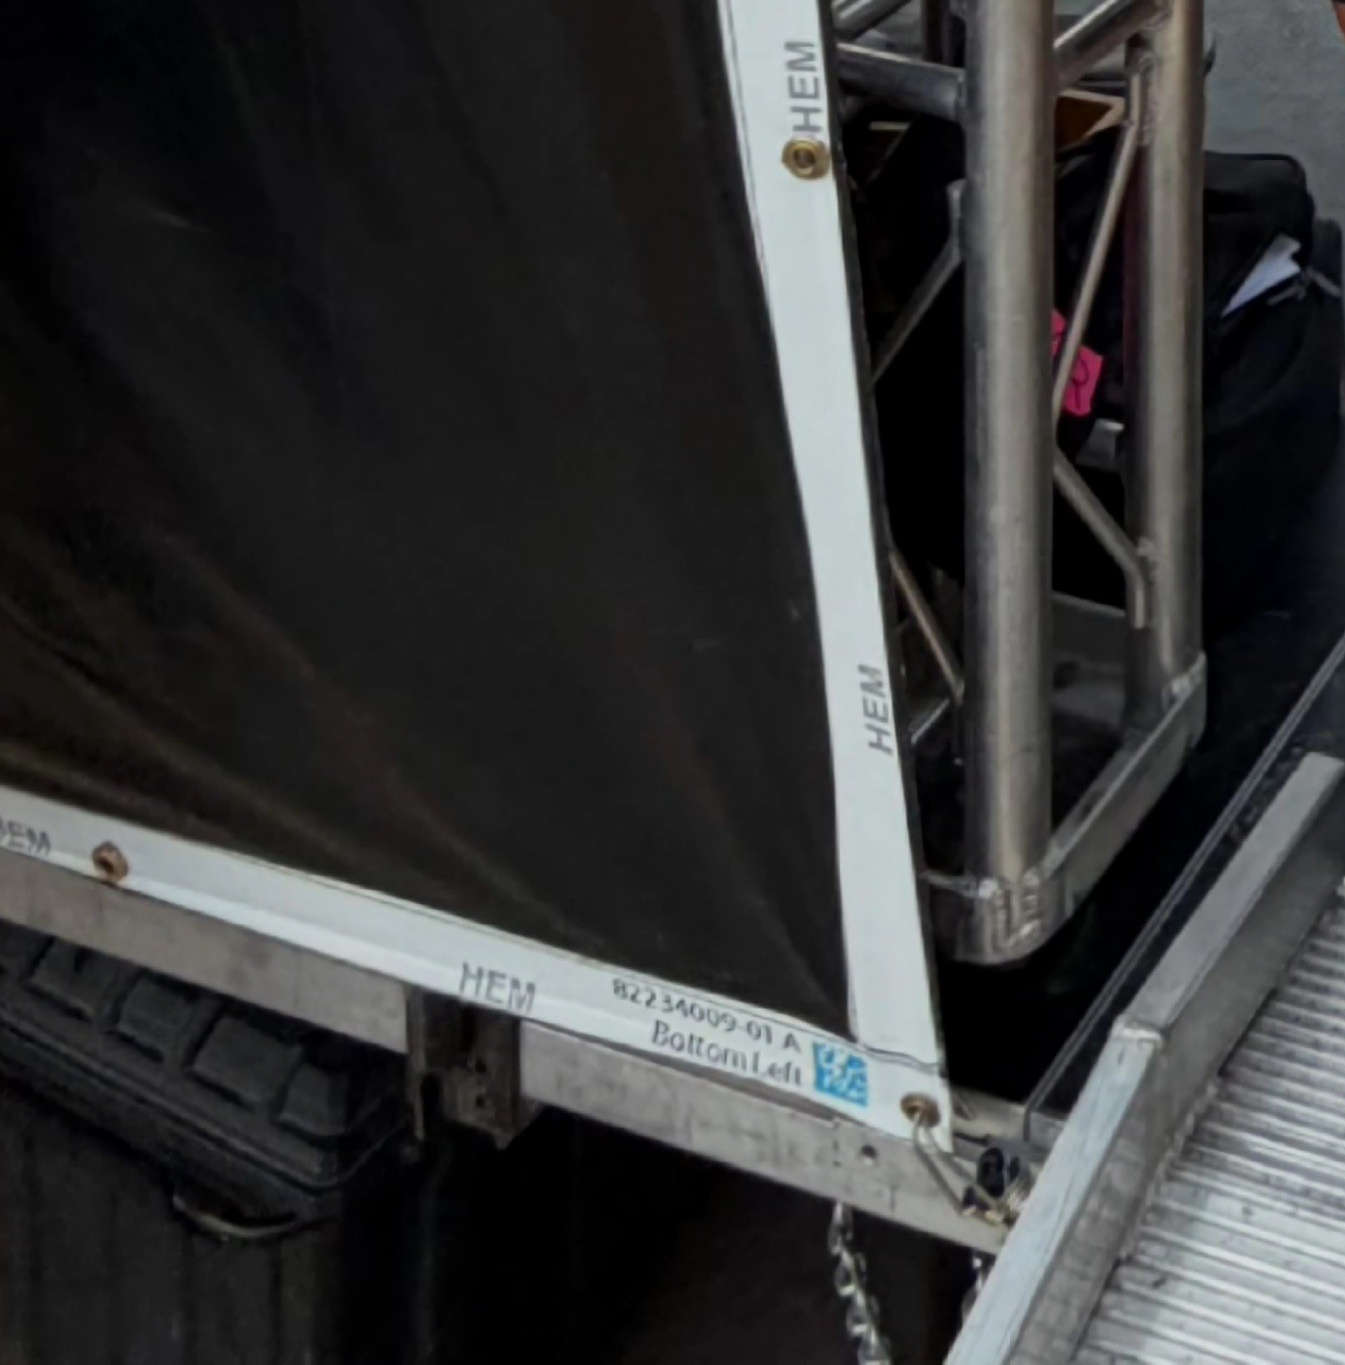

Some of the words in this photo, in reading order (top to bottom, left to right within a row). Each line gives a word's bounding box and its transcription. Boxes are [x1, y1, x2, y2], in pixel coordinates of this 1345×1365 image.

[784, 41, 823, 132] HEM
[857, 663, 894, 757] HEM
[0, 817, 52, 857] EM
[459, 960, 536, 1015] HEM
[783, 1033, 801, 1053] A
